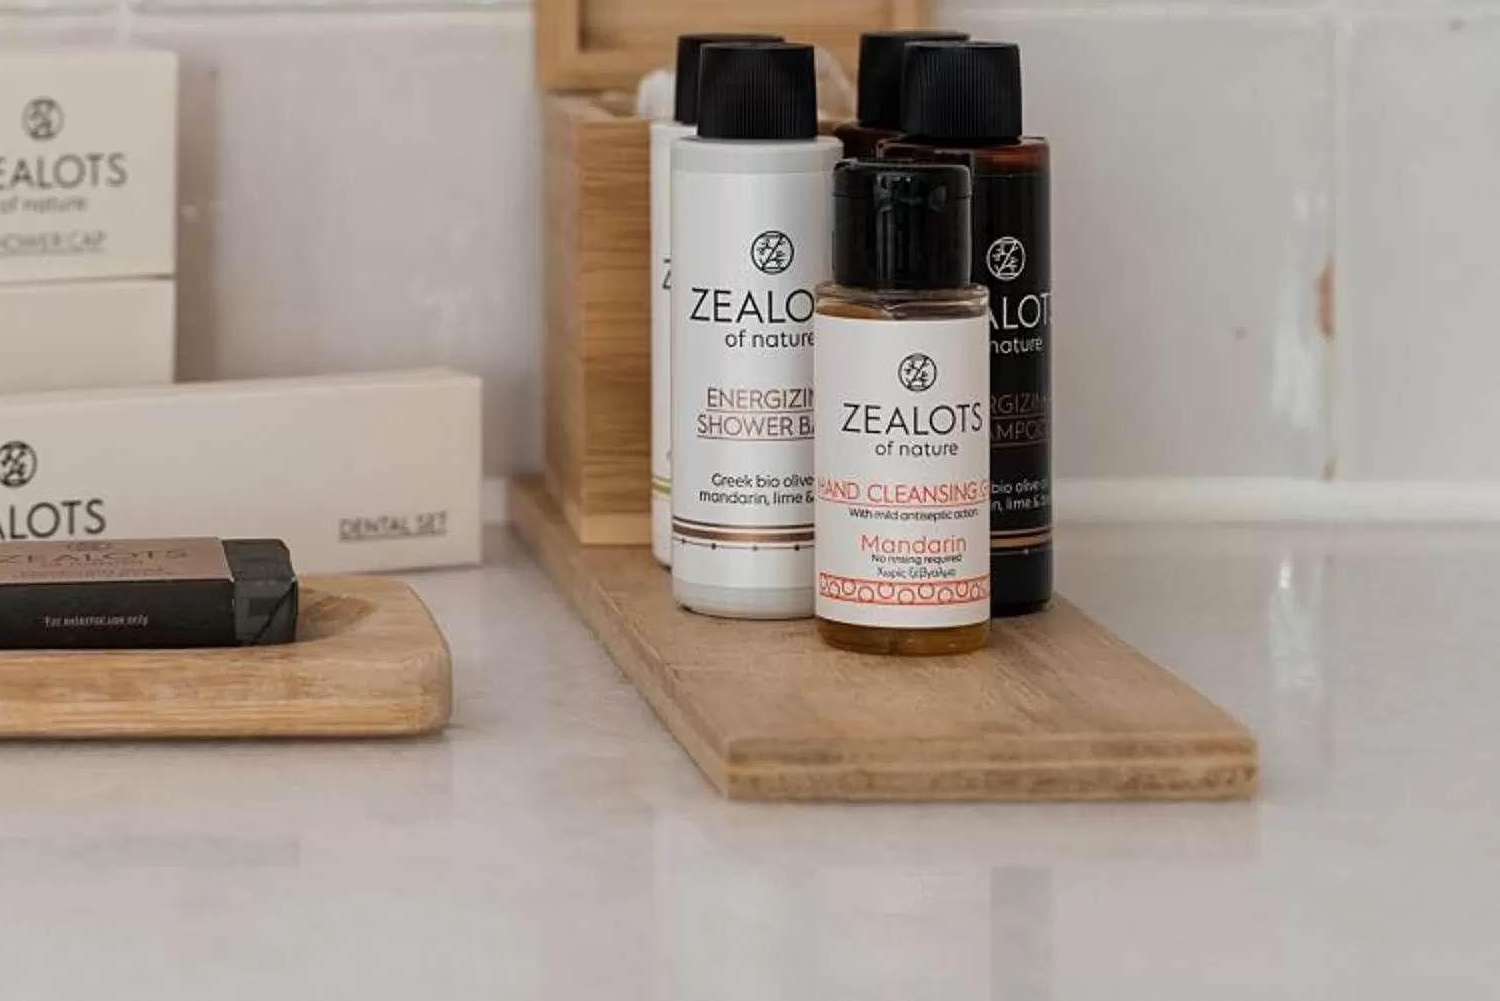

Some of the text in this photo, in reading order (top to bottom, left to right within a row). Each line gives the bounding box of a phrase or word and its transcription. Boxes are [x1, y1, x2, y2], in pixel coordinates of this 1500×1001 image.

[724, 329, 815, 348] of nature
[697, 414, 793, 436] SHOWER
[841, 402, 982, 435] ZEALOTS
[875, 440, 959, 457] of nature
[711, 472, 752, 487] Greek
[756, 474, 780, 487] bio
[700, 490, 770, 506] mandarin,
[773, 492, 803, 505] lime
[867, 481, 977, 503] CLEANSING
[849, 508, 979, 523] With mild antiseptic action
[339, 511, 447, 540] DENTAL SET
[861, 534, 967, 554] Mandarin
[871, 554, 963, 566] No rinsing required
